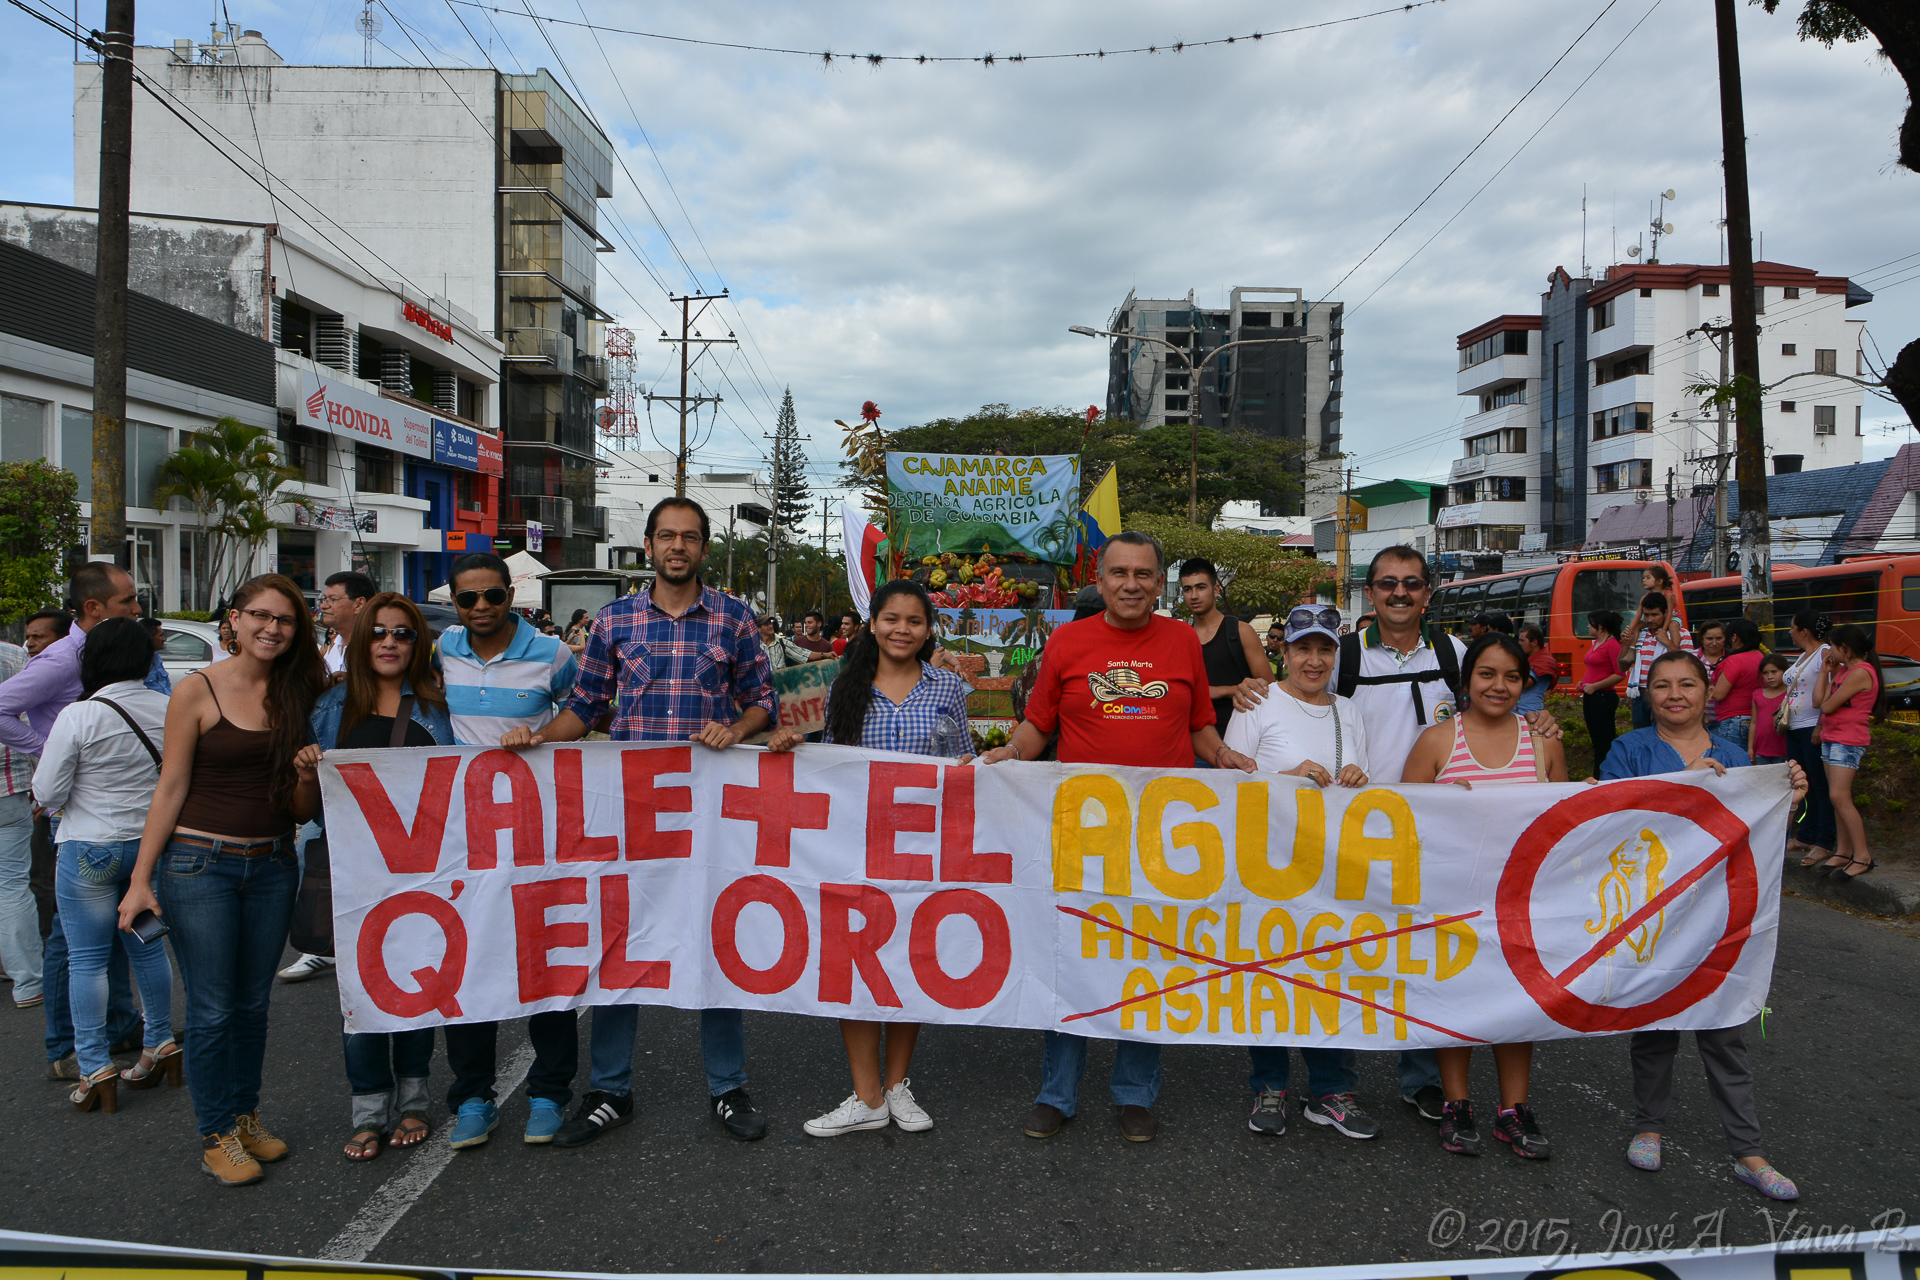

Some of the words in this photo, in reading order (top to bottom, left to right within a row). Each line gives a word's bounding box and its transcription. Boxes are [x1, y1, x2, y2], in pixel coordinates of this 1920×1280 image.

[327, 400, 392, 440] HONDA
[403, 417, 429, 435] Supermotos
[413, 435, 428, 449] Tolima
[457, 433, 473, 446] BAJAJ
[903, 457, 1047, 477] CAJAMARCA
[1069, 454, 1080, 475] Y
[944, 477, 1033, 497] ANAIME
[888, 491, 962, 510] DESPENSA
[973, 488, 1061, 511] AGRICOLA
[909, 509, 934, 523] DE
[946, 509, 1041, 525] COLOMBIA
[1107, 660, 1129, 668] Santa
[1130, 660, 1153, 668] Marta
[334, 746, 692, 874] VALE
[865, 761, 1013, 884] EL
[1051, 772, 1423, 905] AGUA
[511, 873, 671, 1004] EL
[711, 874, 1012, 1009] ORO
[1080, 901, 1479, 981] ANGLOGOLD
[1120, 965, 1407, 1040] ASHANTI
